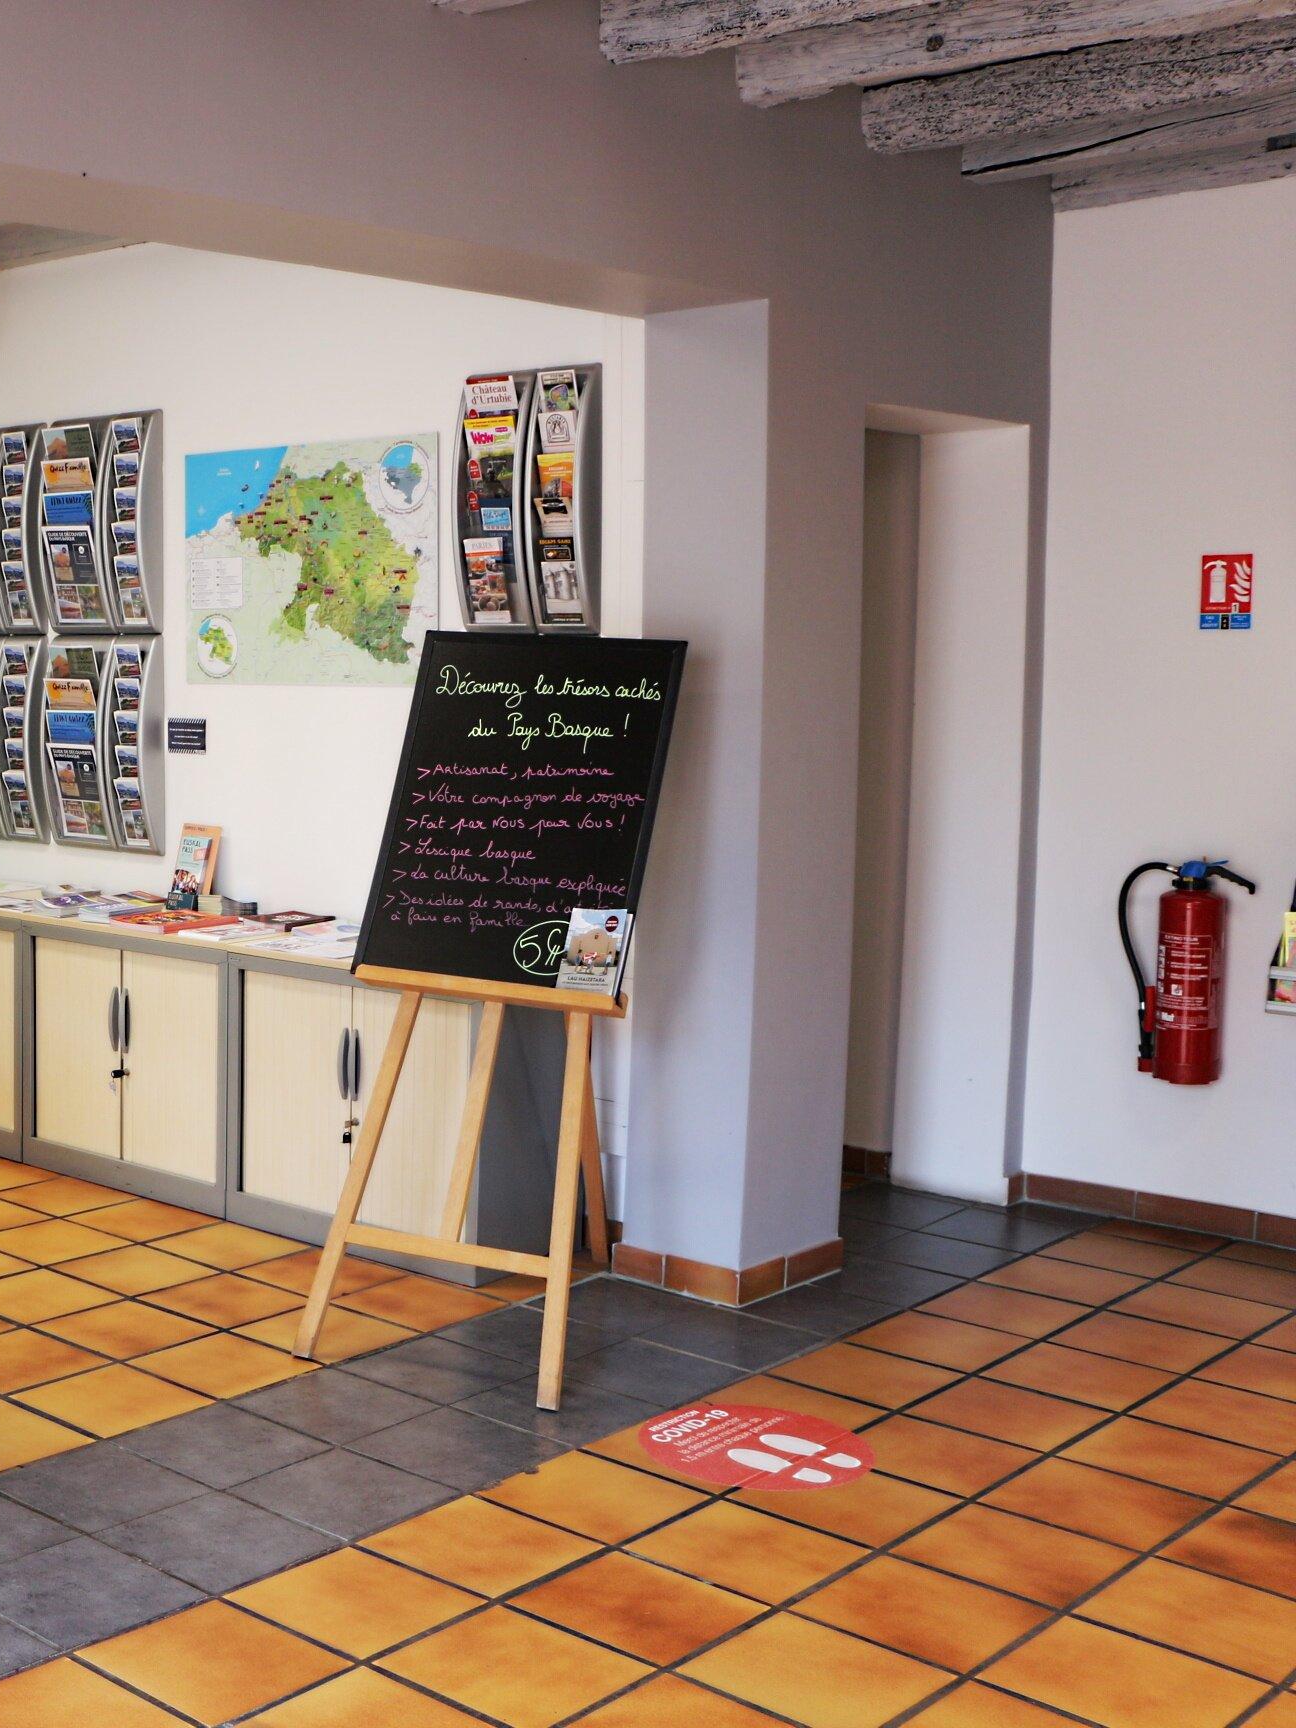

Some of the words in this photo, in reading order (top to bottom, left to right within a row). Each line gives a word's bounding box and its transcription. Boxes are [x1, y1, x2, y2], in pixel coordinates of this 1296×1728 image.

[471, 385, 508, 395] Château
[471, 394, 512, 405] d'Urtubie
[436, 665, 528, 709] Découvrez
[535, 674, 554, 695] les
[557, 677, 611, 698] trésors
[614, 678, 662, 701] cachés
[468, 719, 498, 738] du
[507, 712, 541, 751] Pays
[544, 713, 614, 755] Basque
[623, 713, 631, 738] !
[521, 762, 615, 780] patrimoine
[429, 782, 465, 804] Votre
[472, 793, 557, 810] compagnon
[561, 786, 582, 804] de
[586, 793, 646, 809] voyage
[419, 814, 444, 829] Fait
[450, 817, 487, 836] par
[492, 816, 525, 829] NOUS
[529, 819, 571, 838] pour
[577, 812, 614, 829] VOUS
[618, 814, 626, 832] !
[181, 846, 193, 854] PASS
[183, 839, 201, 848] EUSKAL
[415, 837, 473, 863] Lexique
[479, 840, 536, 868] basque
[410, 863, 430, 881] La
[434, 865, 491, 882] culture
[496, 866, 552, 894] basque
[556, 875, 628, 900] expliquée
[399, 890, 424, 906] Des
[427, 890, 464, 907] idées
[467, 894, 488, 908] de
[390, 910, 401, 922] à
[407, 907, 438, 926] faire
[443, 914, 462, 924] en
[648, 1409, 700, 1432] RESTRICTION
[651, 1409, 730, 1443] COVID-19
[673, 1434, 699, 1448] Merci
